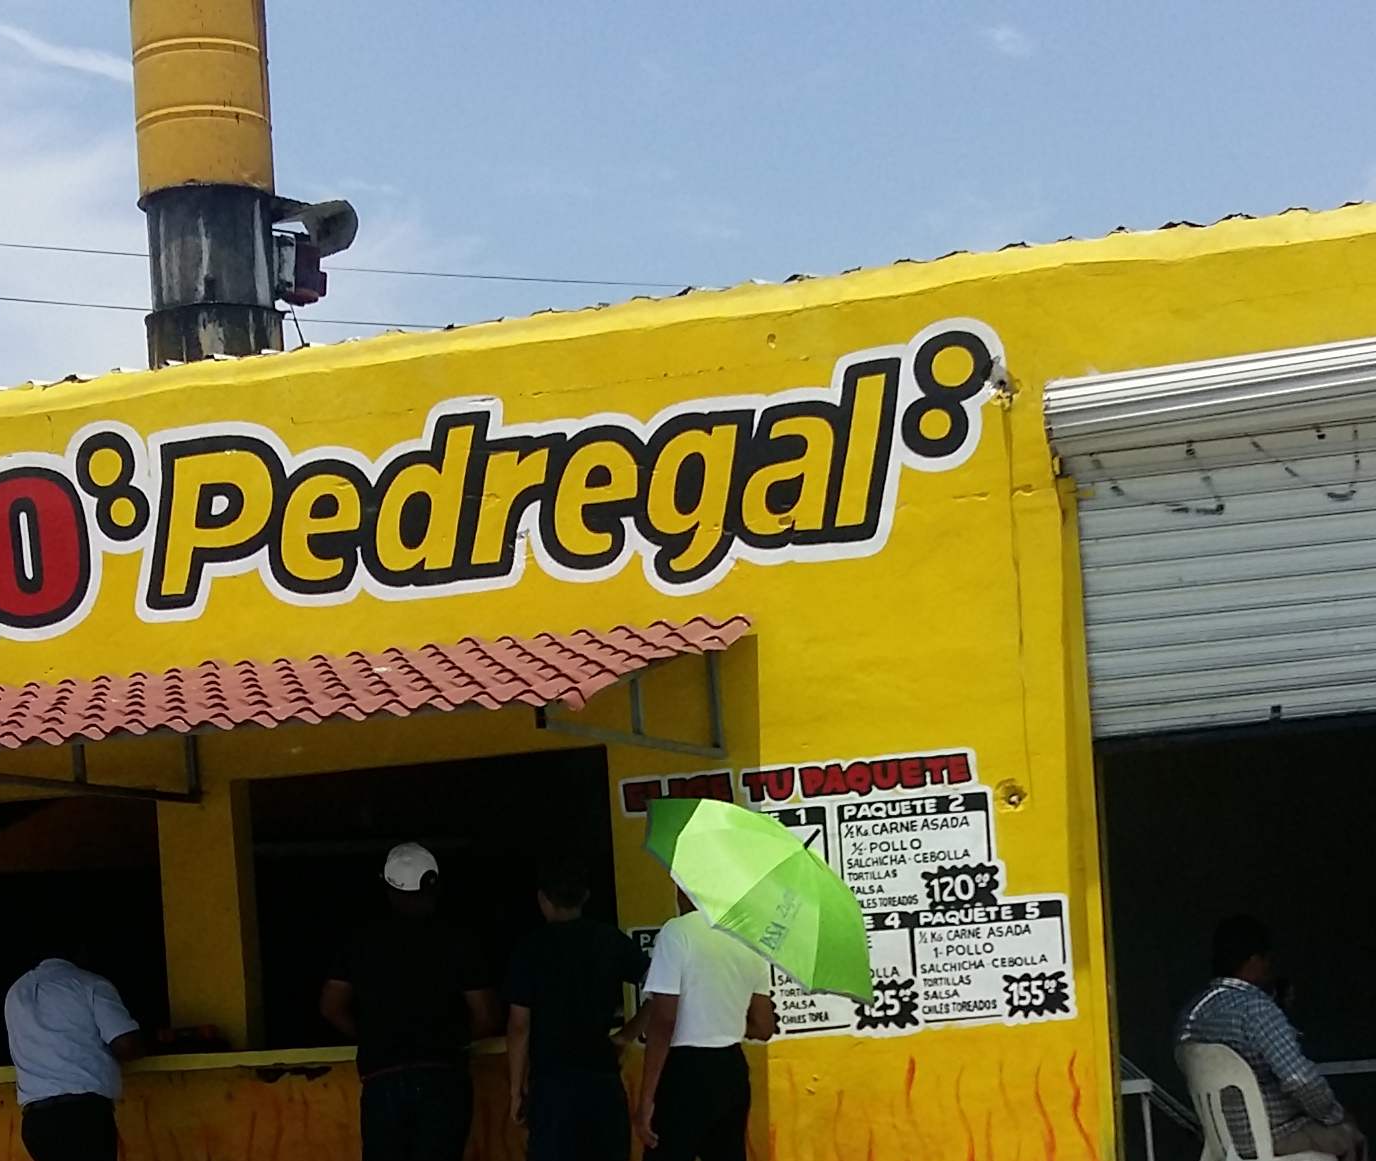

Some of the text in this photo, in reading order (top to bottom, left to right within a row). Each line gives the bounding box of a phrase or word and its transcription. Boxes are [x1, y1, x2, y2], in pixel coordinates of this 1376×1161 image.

[146, 358, 901, 609] Pedregal
[742, 767, 795, 802] TU
[798, 753, 972, 798] PAQUETE
[843, 794, 966, 820] PAQUETE 2
[871, 820, 918, 836] CARNE
[920, 815, 970, 831] ASADA
[869, 838, 922, 853] POLLO
[847, 868, 898, 882] TORTILLAS
[884, 912, 901, 929] 4
[919, 901, 1040, 925] PAQUETE 5
[946, 926, 982, 941] CARNE
[987, 924, 1032, 939] ASADA
[946, 942, 994, 957] POLLO
[923, 989, 960, 1000] SALSA
[782, 999, 816, 1010] SALSA
